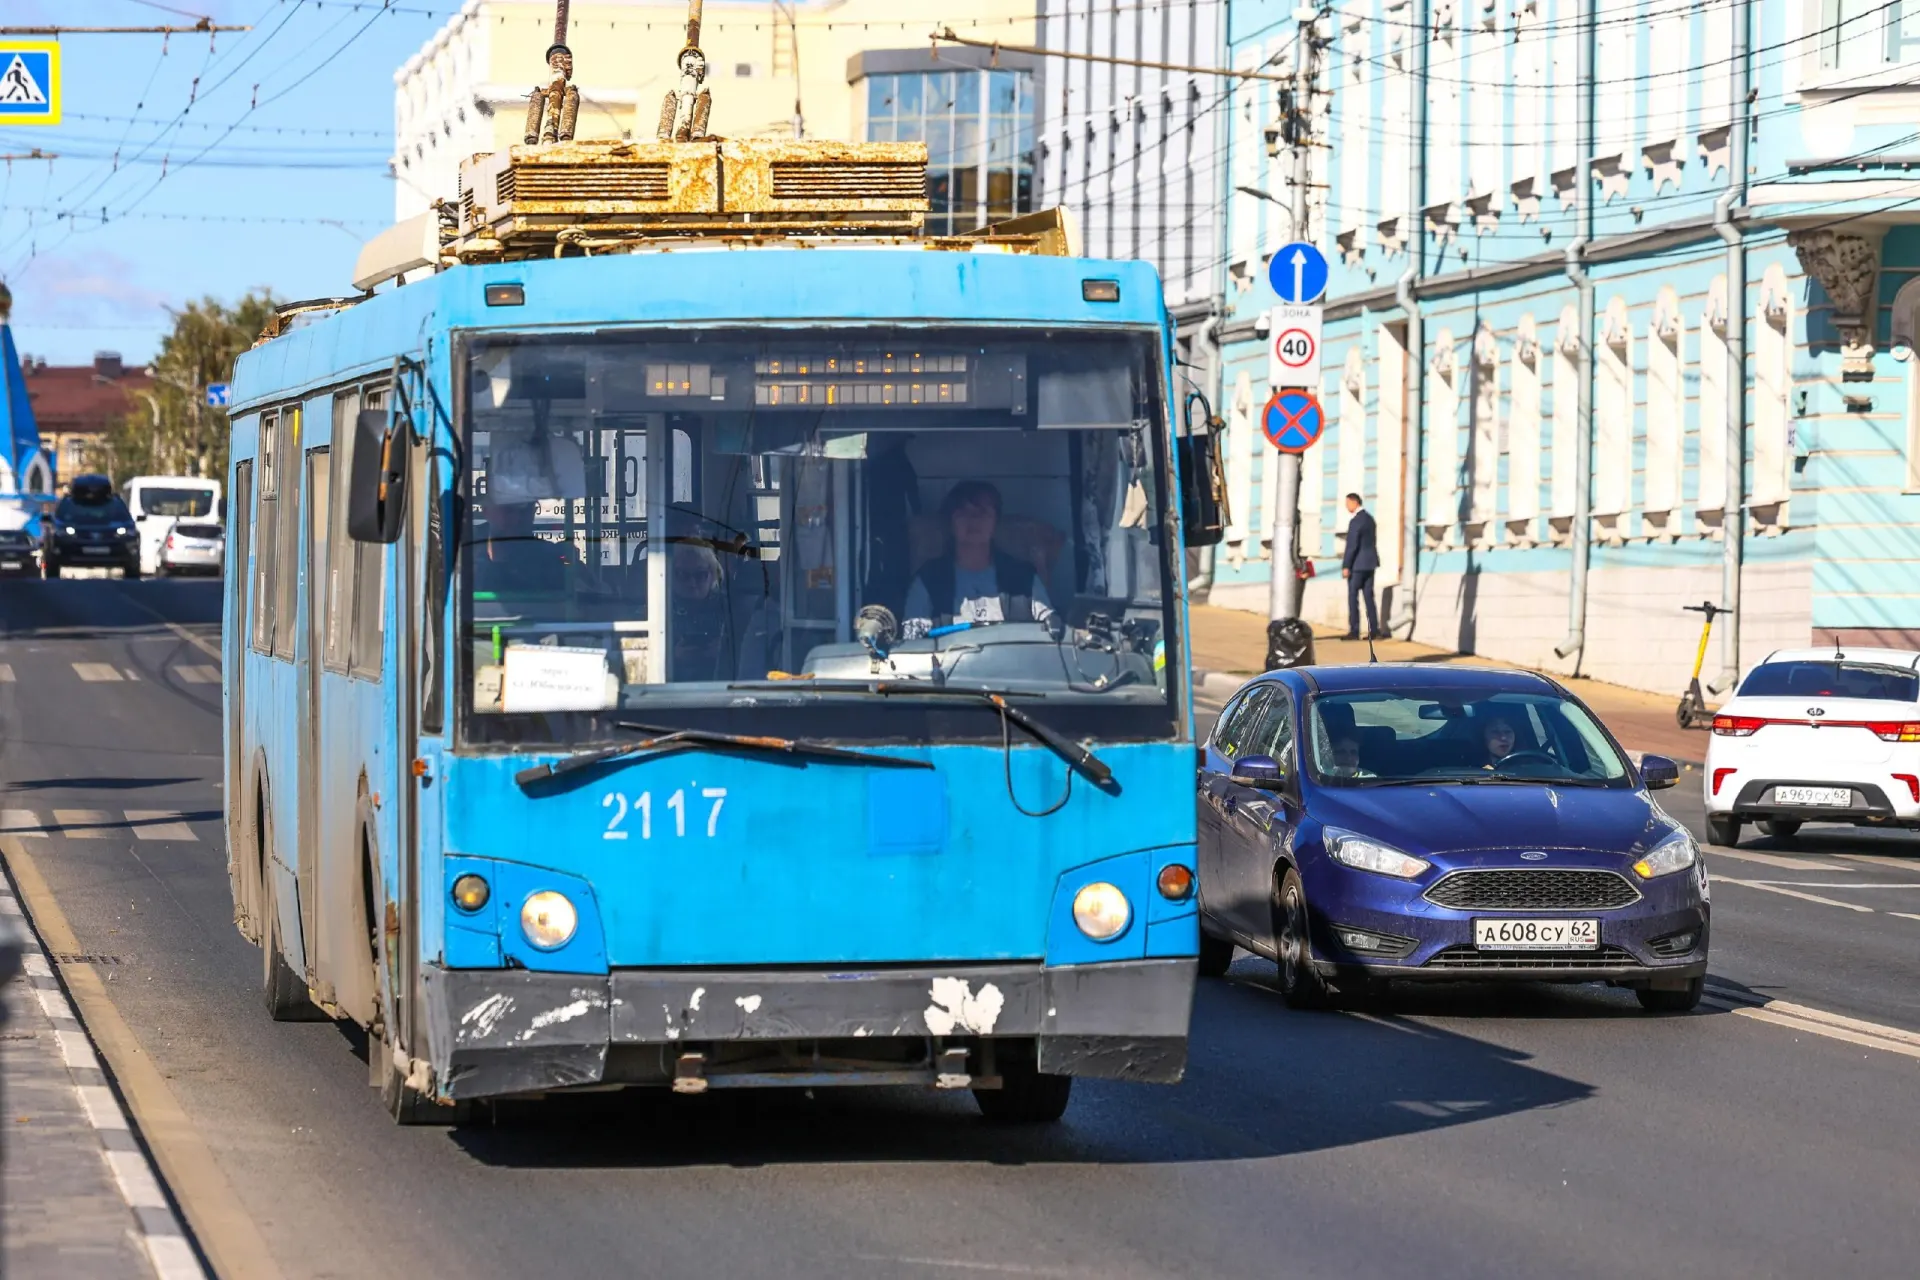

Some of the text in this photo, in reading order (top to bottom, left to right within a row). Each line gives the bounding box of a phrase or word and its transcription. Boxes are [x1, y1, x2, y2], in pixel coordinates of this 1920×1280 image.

[1282, 308, 1311, 317] ЗОНА
[1283, 339, 1307, 357] 40
[1808, 708, 1824, 716] KIA
[602, 788, 727, 839] 2117
[1571, 921, 1591, 936] 62
